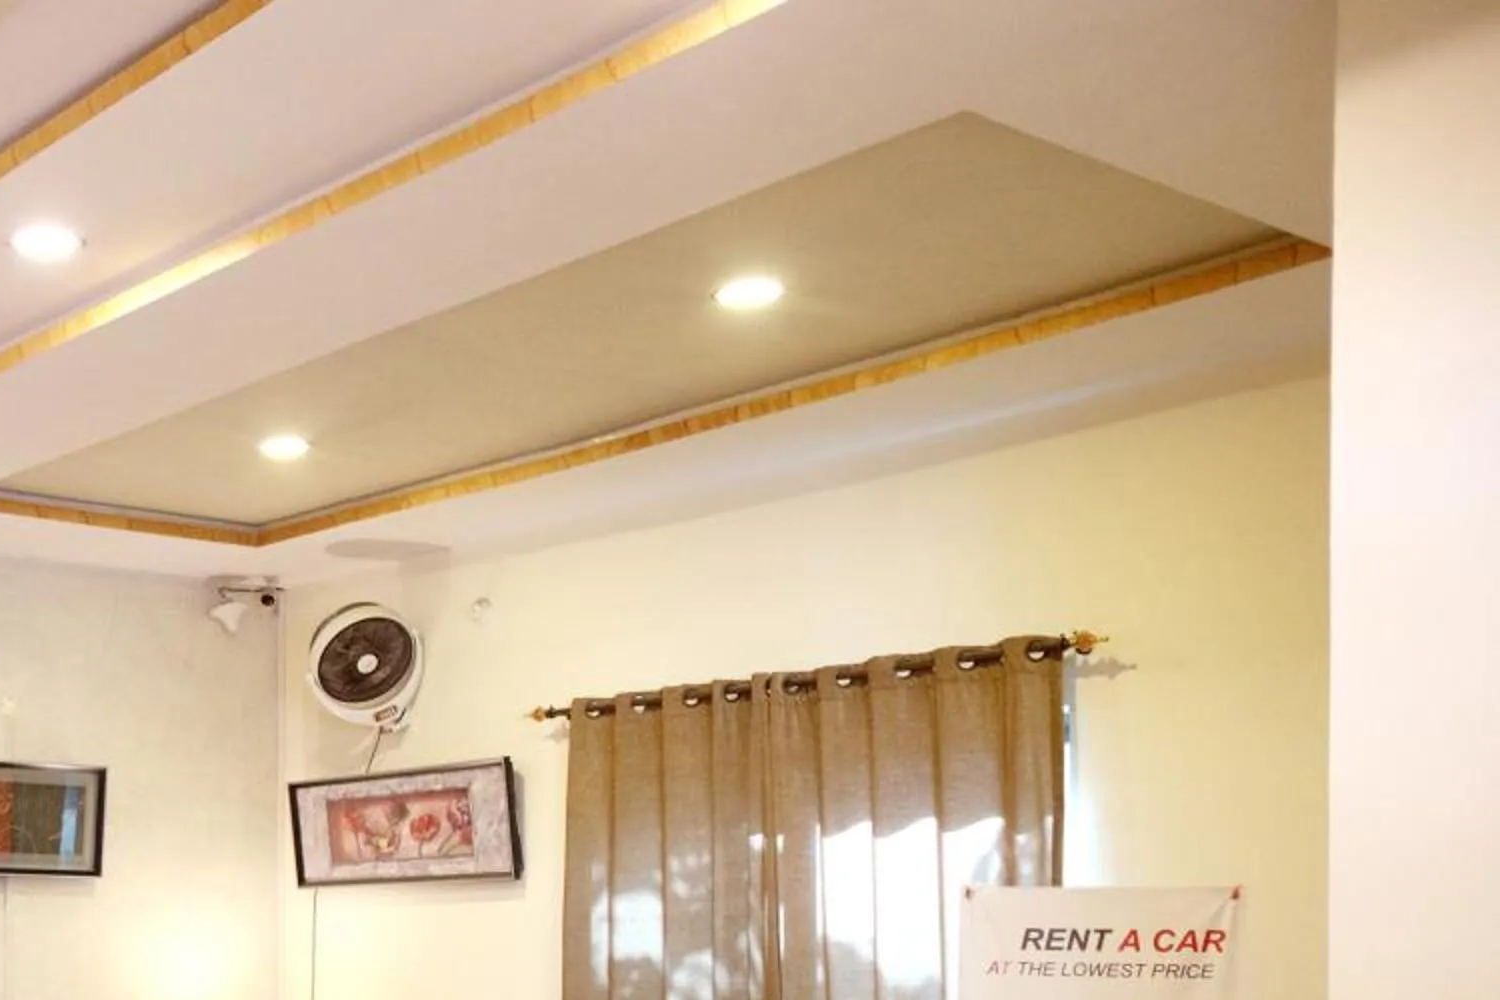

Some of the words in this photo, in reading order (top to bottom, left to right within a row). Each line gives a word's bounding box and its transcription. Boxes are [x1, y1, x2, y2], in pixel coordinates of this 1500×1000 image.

[1020, 927, 1113, 953] RENT
[1117, 929, 1141, 954] A
[1152, 929, 1227, 954] CAR
[987, 961, 1013, 976] AT
[1018, 961, 1056, 977] THE
[1060, 962, 1148, 979] LOWEST
[1151, 963, 1215, 980] PRICE
